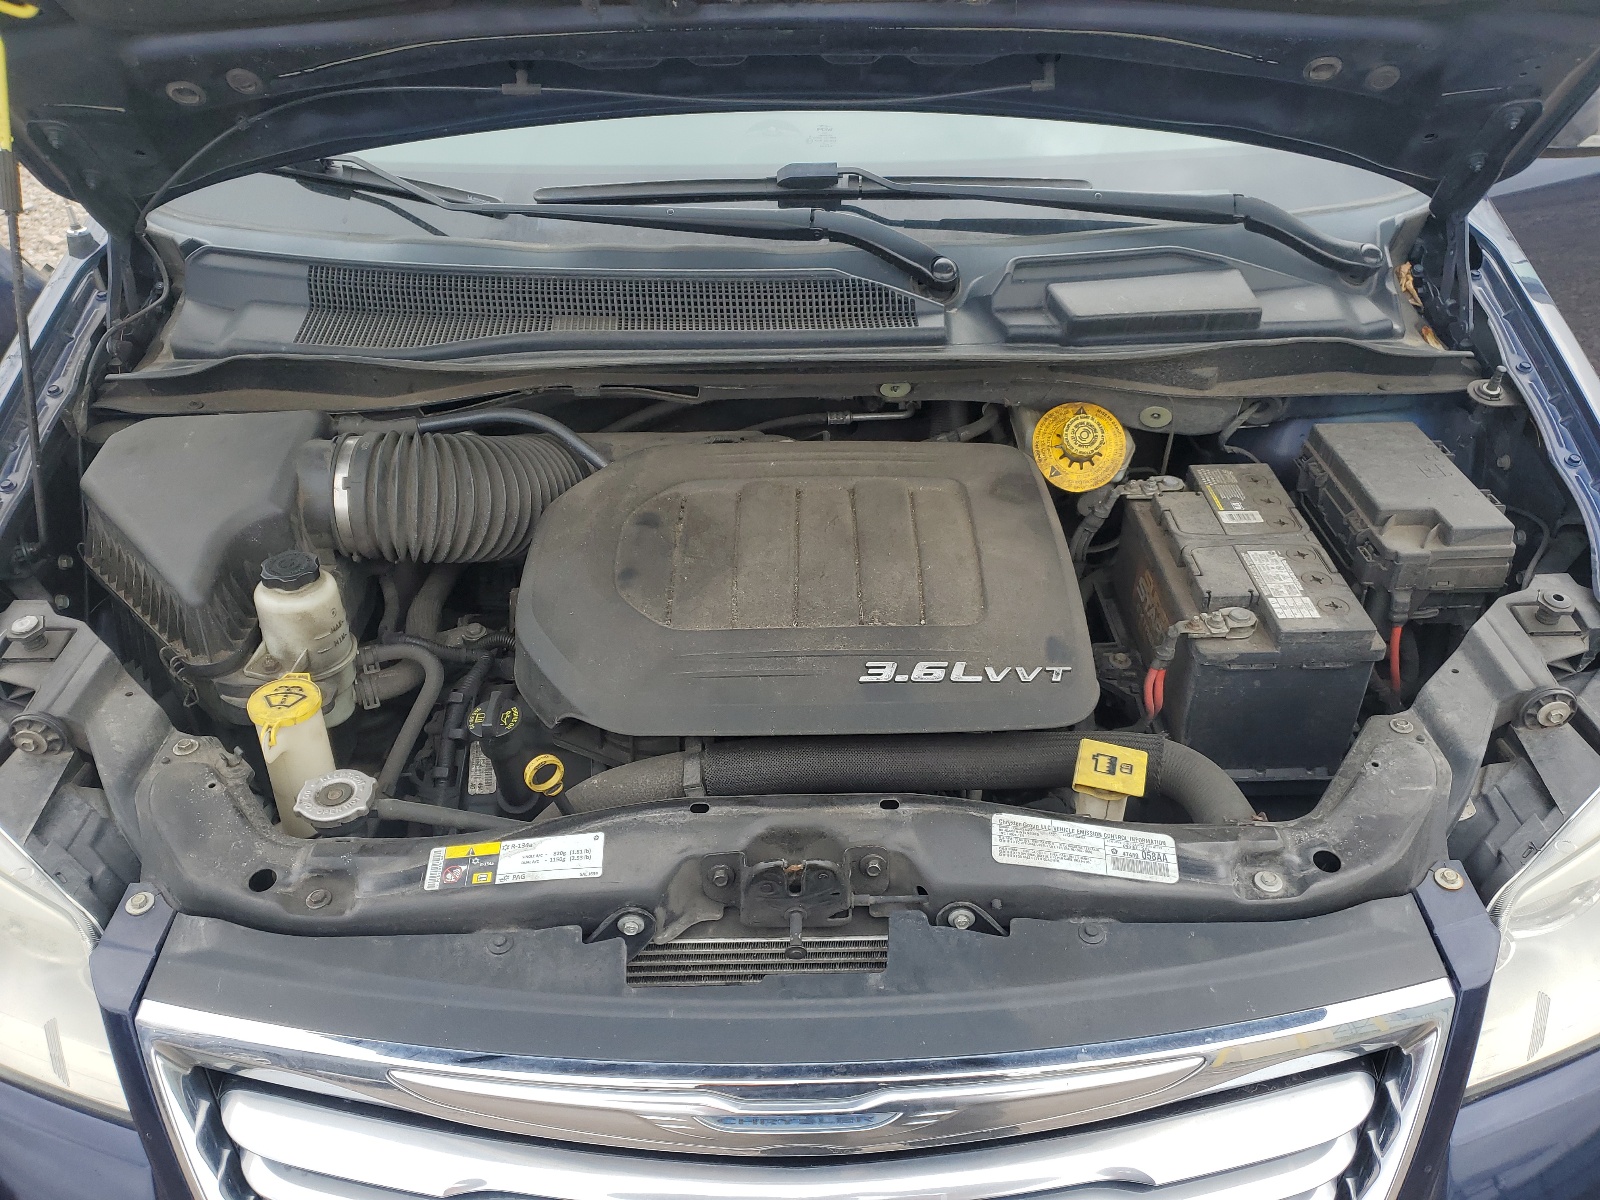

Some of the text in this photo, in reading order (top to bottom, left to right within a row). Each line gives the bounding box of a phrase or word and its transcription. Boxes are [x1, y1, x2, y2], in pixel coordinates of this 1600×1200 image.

[858, 661, 1072, 683] 3.6L VVT
[1142, 850, 1168, 862] 058AA
[718, 1116, 875, 1125] CHRYSLER
